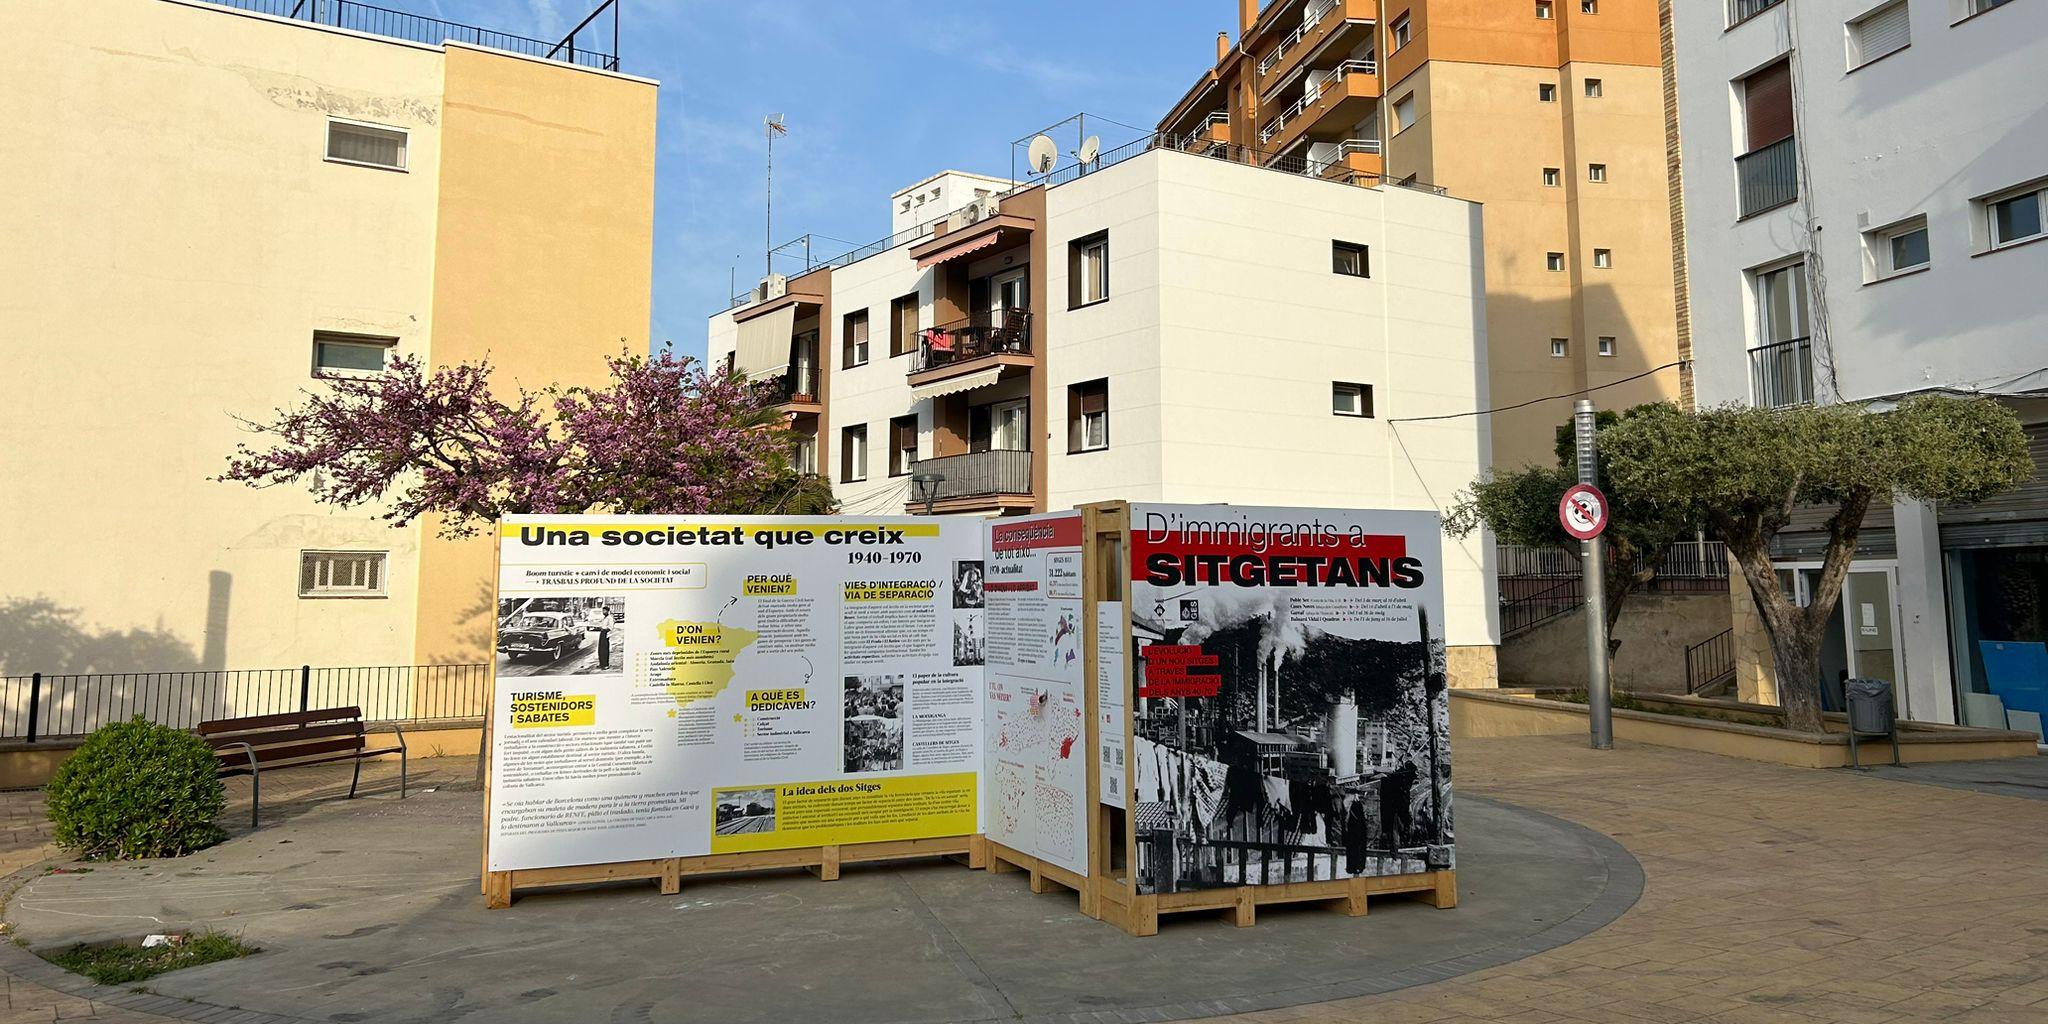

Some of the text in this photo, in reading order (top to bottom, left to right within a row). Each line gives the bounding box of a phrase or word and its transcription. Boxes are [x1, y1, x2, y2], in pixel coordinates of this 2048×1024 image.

[521, 526, 904, 550] Una societat que creix
[994, 529, 1003, 543] La
[1146, 512, 1366, 553] D'immigrants a
[848, 552, 922, 564] 1940-1970
[995, 547, 1003, 560] de
[1005, 547, 1014, 559] tot
[1145, 553, 1425, 588] SITGETANS
[748, 574, 767, 583] PER
[845, 581, 866, 589] VIES
[870, 578, 936, 589] D'INTEGRACIÓ
[747, 584, 790, 593] VENIEN?
[845, 589, 934, 599] VIA DE SEPARACIÓ
[1190, 601, 1198, 619] GES
[677, 626, 702, 634] D'ON
[676, 635, 721, 645] VENIEN?
[511, 691, 566, 701] TURISME,
[751, 693, 758, 701] A
[786, 691, 799, 699] ES
[510, 701, 593, 712] SOSTENIDORS
[751, 700, 816, 711] DEDICAVEN?
[510, 713, 569, 724] I SABATES
[783, 783, 881, 796] La idea dels dos Sitges
